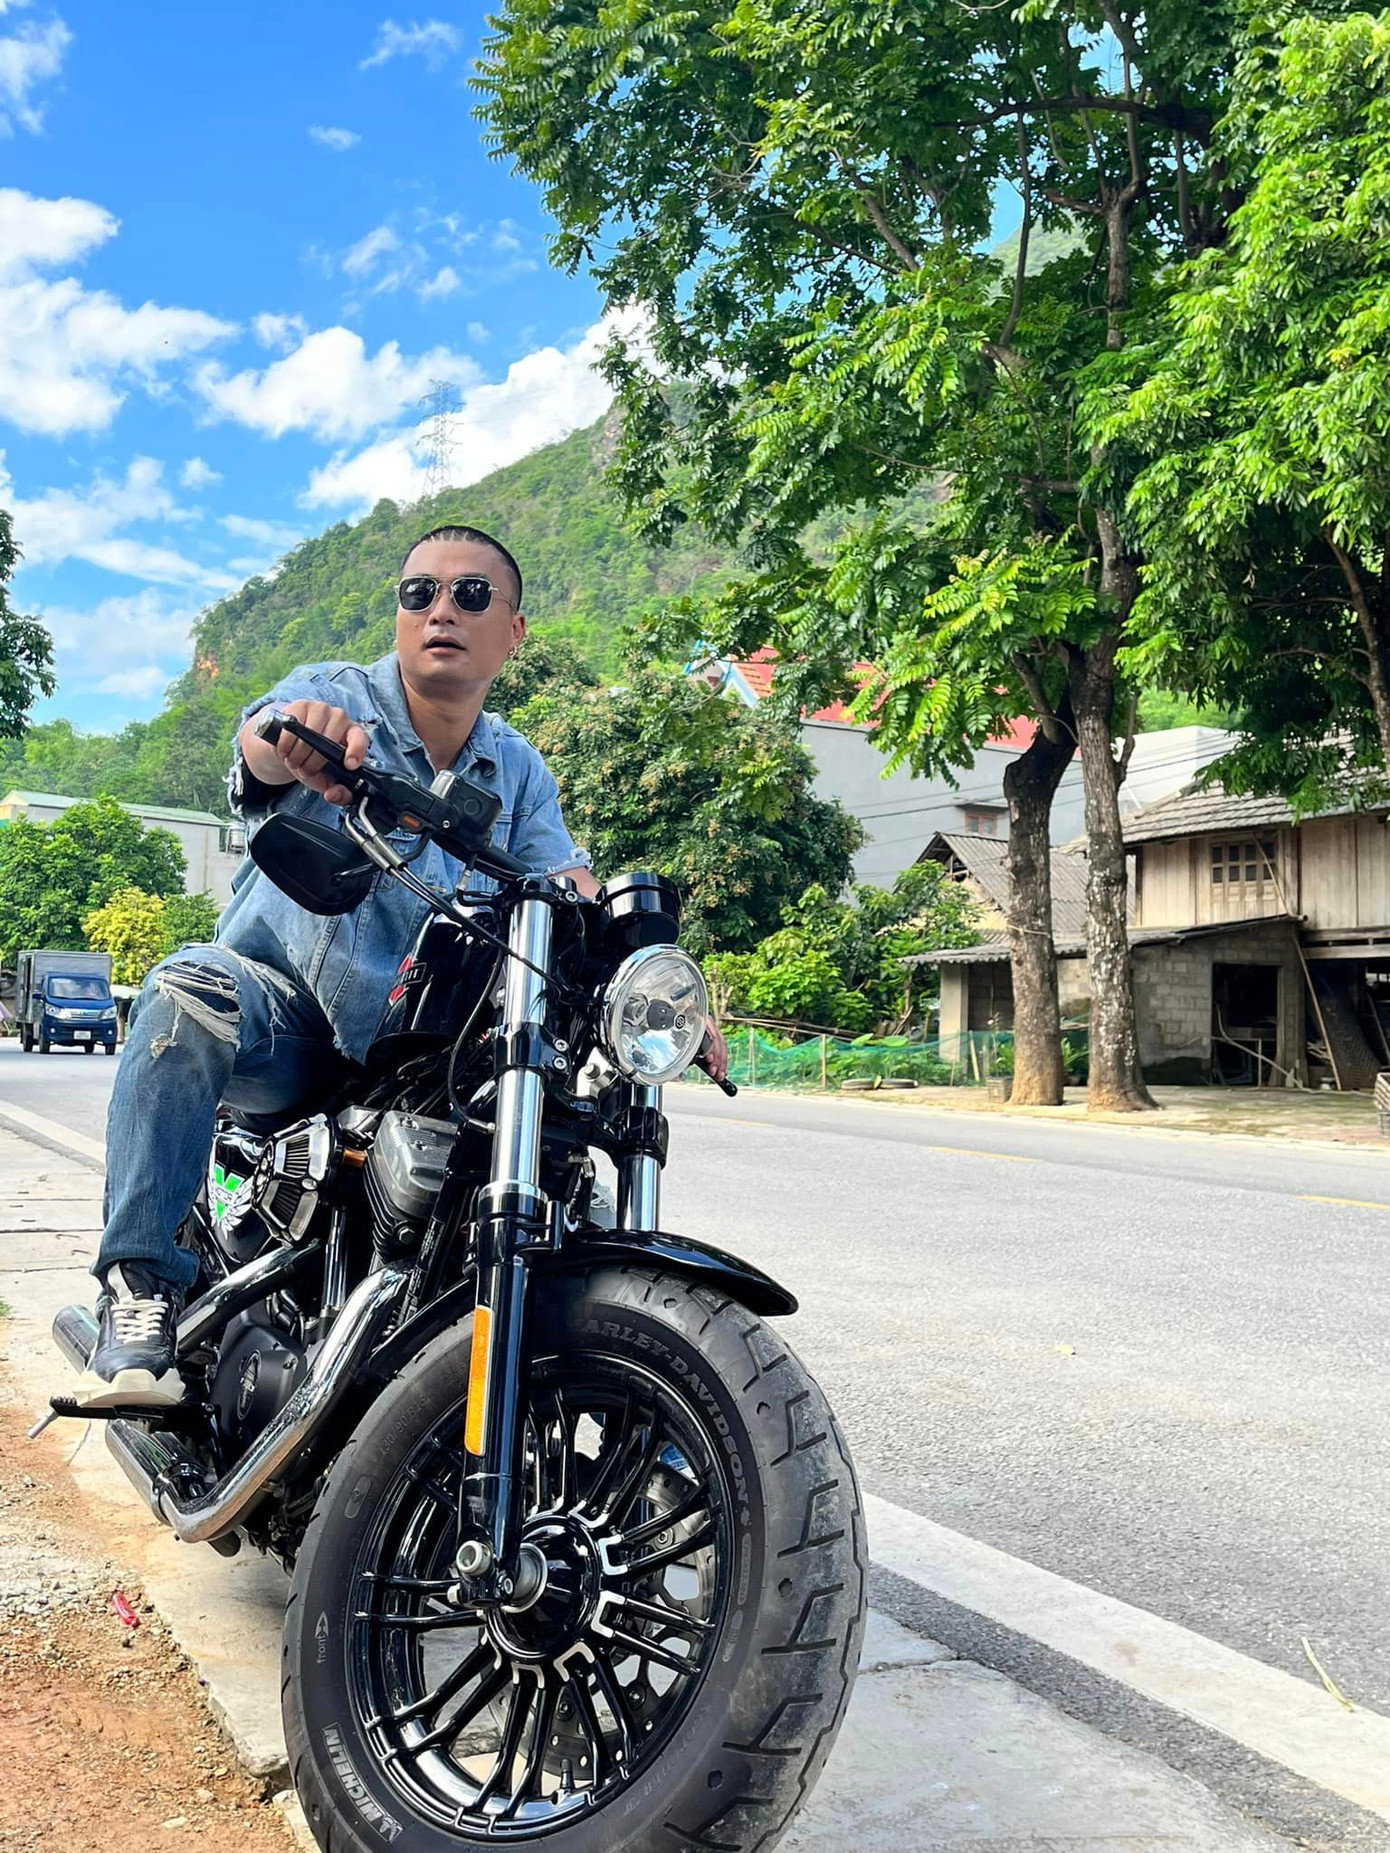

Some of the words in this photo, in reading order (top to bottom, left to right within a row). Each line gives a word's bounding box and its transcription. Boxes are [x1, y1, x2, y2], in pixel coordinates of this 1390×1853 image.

[580, 1319, 749, 1505] ARLEY-DAVIDSON
[315, 1635, 327, 1664] front
[324, 1728, 383, 1822] MICHELIN
